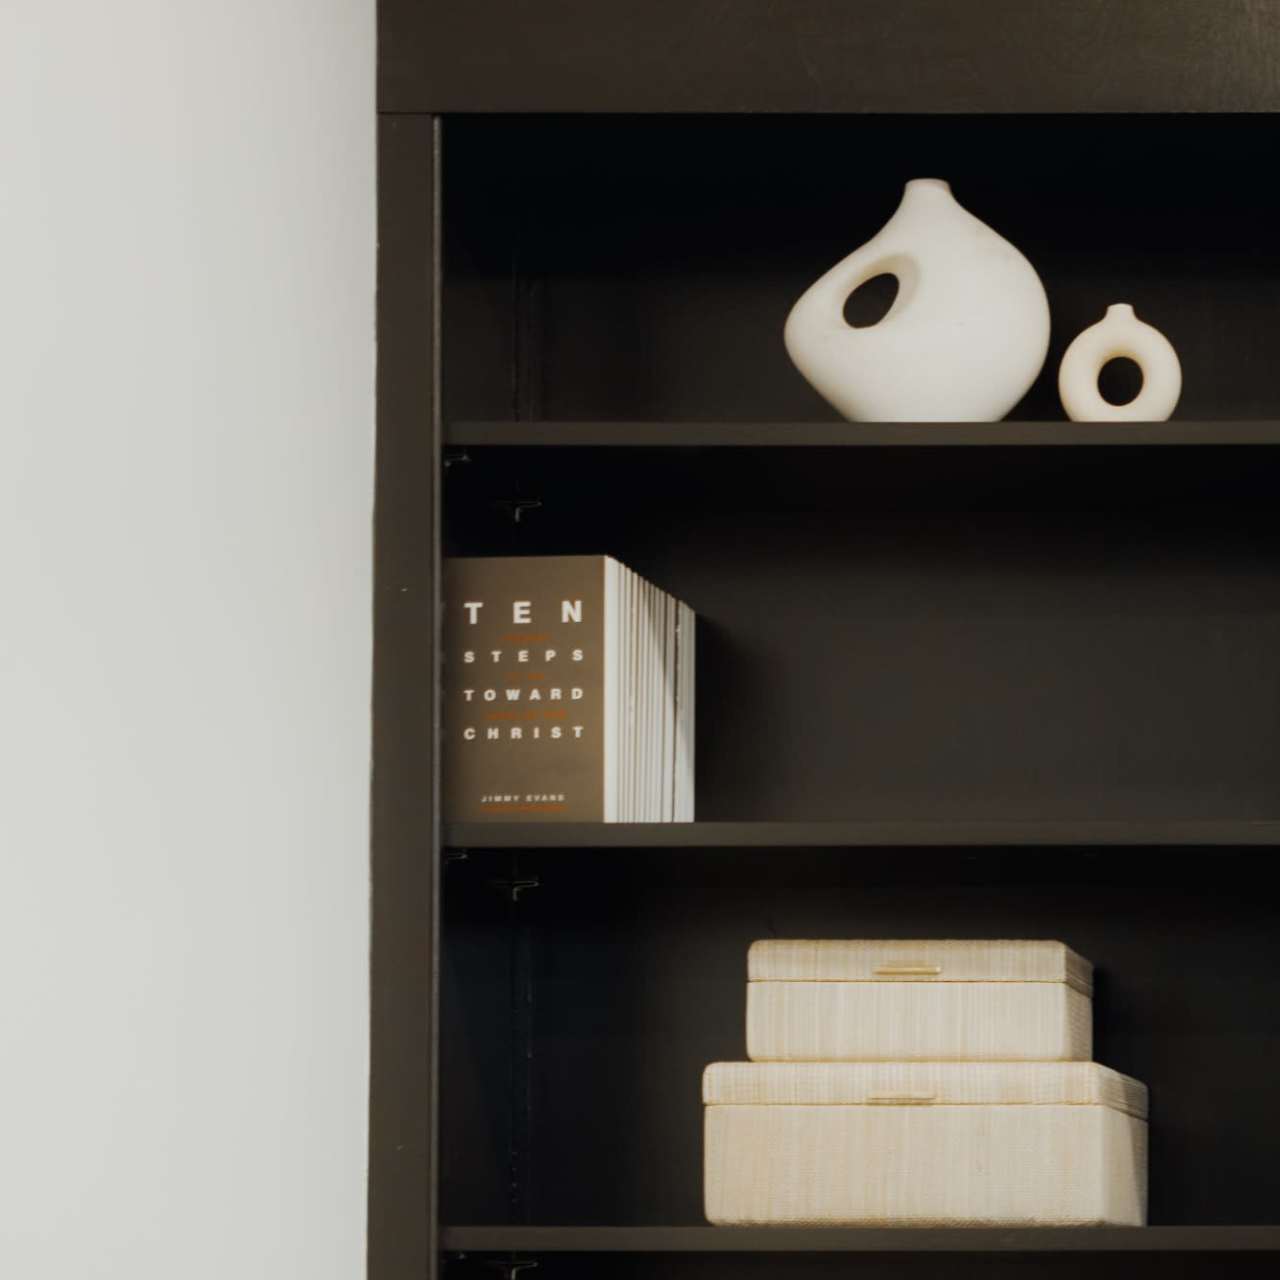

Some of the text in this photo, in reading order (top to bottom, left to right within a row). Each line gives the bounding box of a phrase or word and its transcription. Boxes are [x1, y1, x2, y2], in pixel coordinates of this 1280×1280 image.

[464, 600, 583, 624] TEN
[464, 650, 583, 663] STEPS
[464, 689, 583, 701] TOWARD
[464, 726, 584, 740] CHRIST
